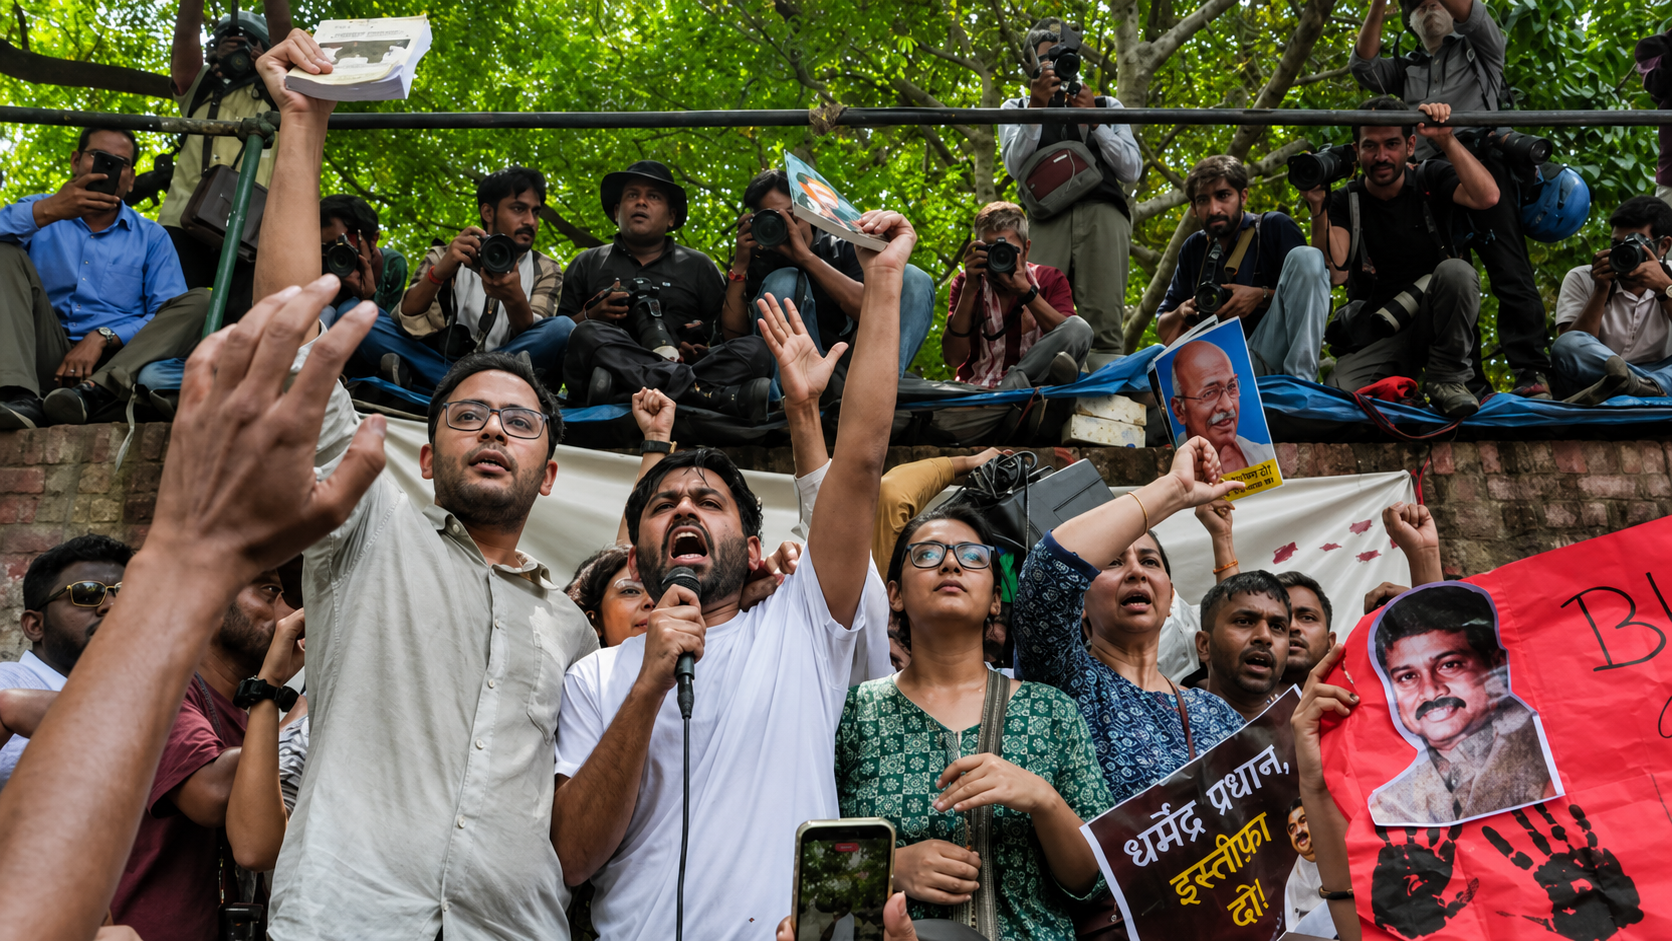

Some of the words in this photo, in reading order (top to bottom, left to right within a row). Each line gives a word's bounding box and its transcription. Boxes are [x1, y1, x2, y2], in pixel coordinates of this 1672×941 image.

[1123, 800, 1206, 867] धर्मेंद्र
[1206, 744, 1289, 816] प्रधान,
[1169, 812, 1272, 906] इस्तीफ़ा
[1227, 878, 1269, 927] दो!
